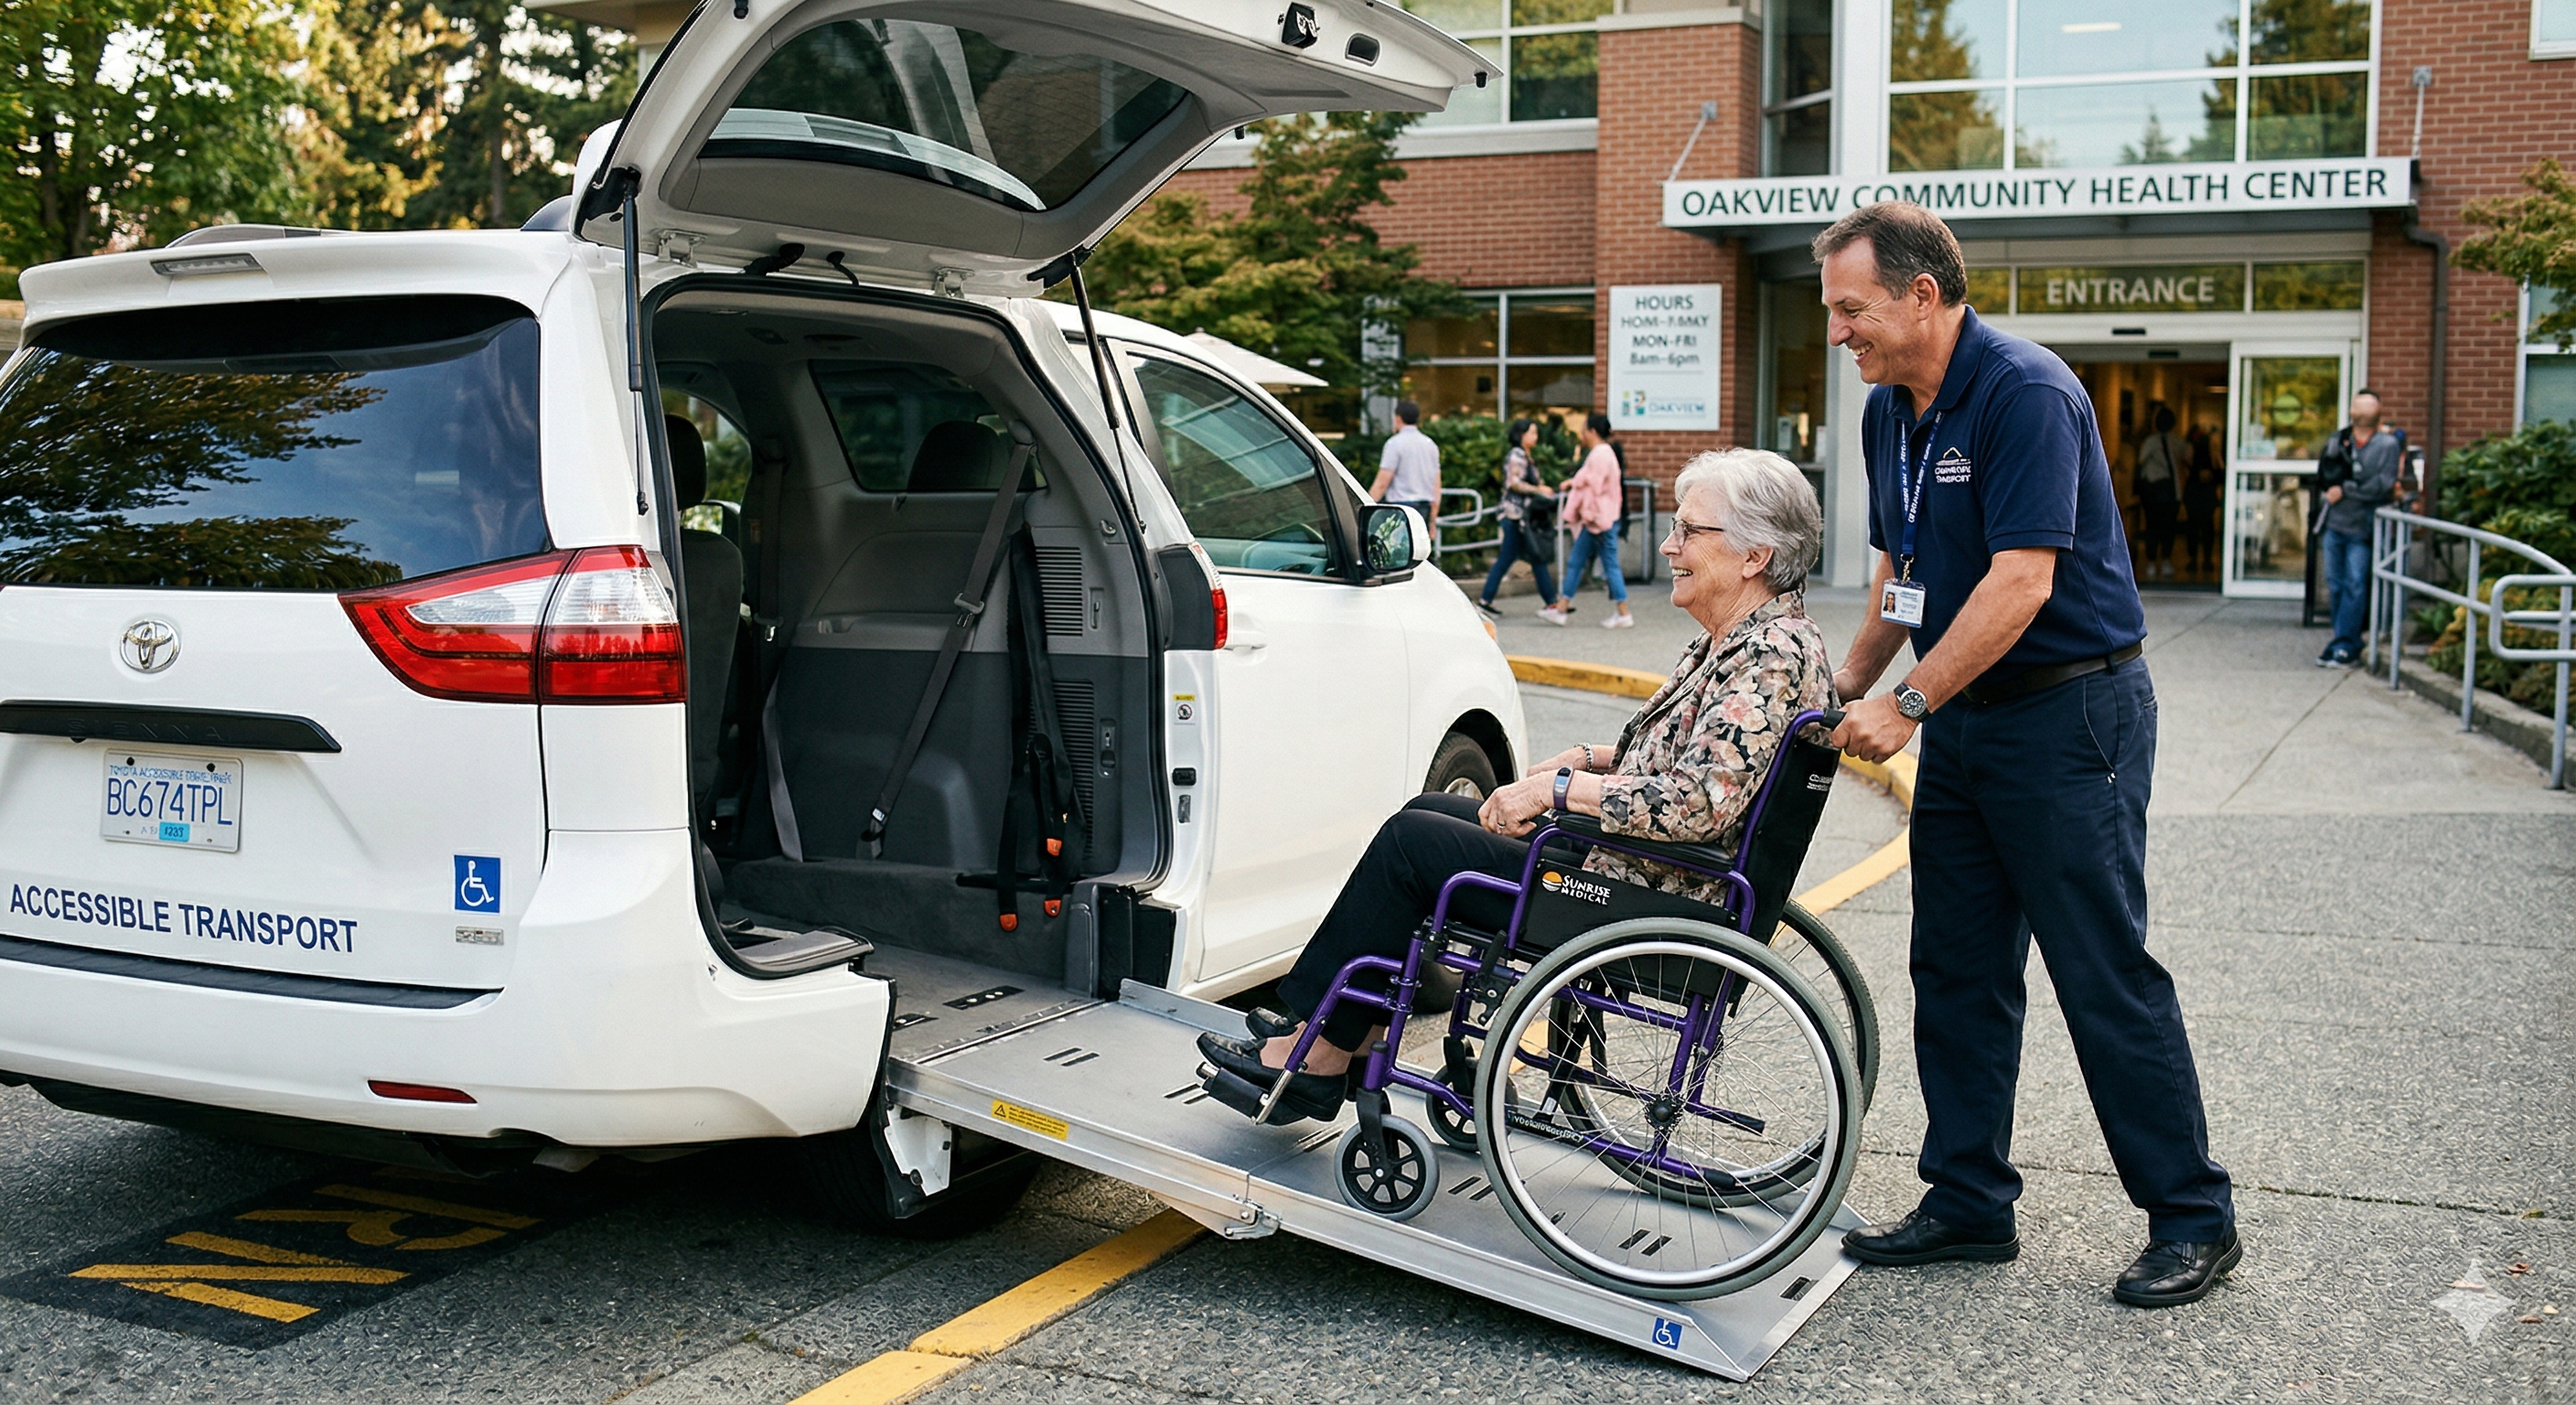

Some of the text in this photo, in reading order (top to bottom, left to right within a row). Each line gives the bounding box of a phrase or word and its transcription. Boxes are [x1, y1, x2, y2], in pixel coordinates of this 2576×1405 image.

[1682, 168, 2388, 216] OAKVIEW COMMUNITY HEALTH CENTER
[1635, 295, 1693, 310] HOURS
[2046, 275, 2215, 306] ENTRANCE
[1633, 335, 1697, 348] MON-FRI
[107, 778, 233, 825] BC674TPL
[1562, 874, 1611, 898] SUNRISE
[10, 883, 358, 953] ACCESSIBLE TRANSPORT
